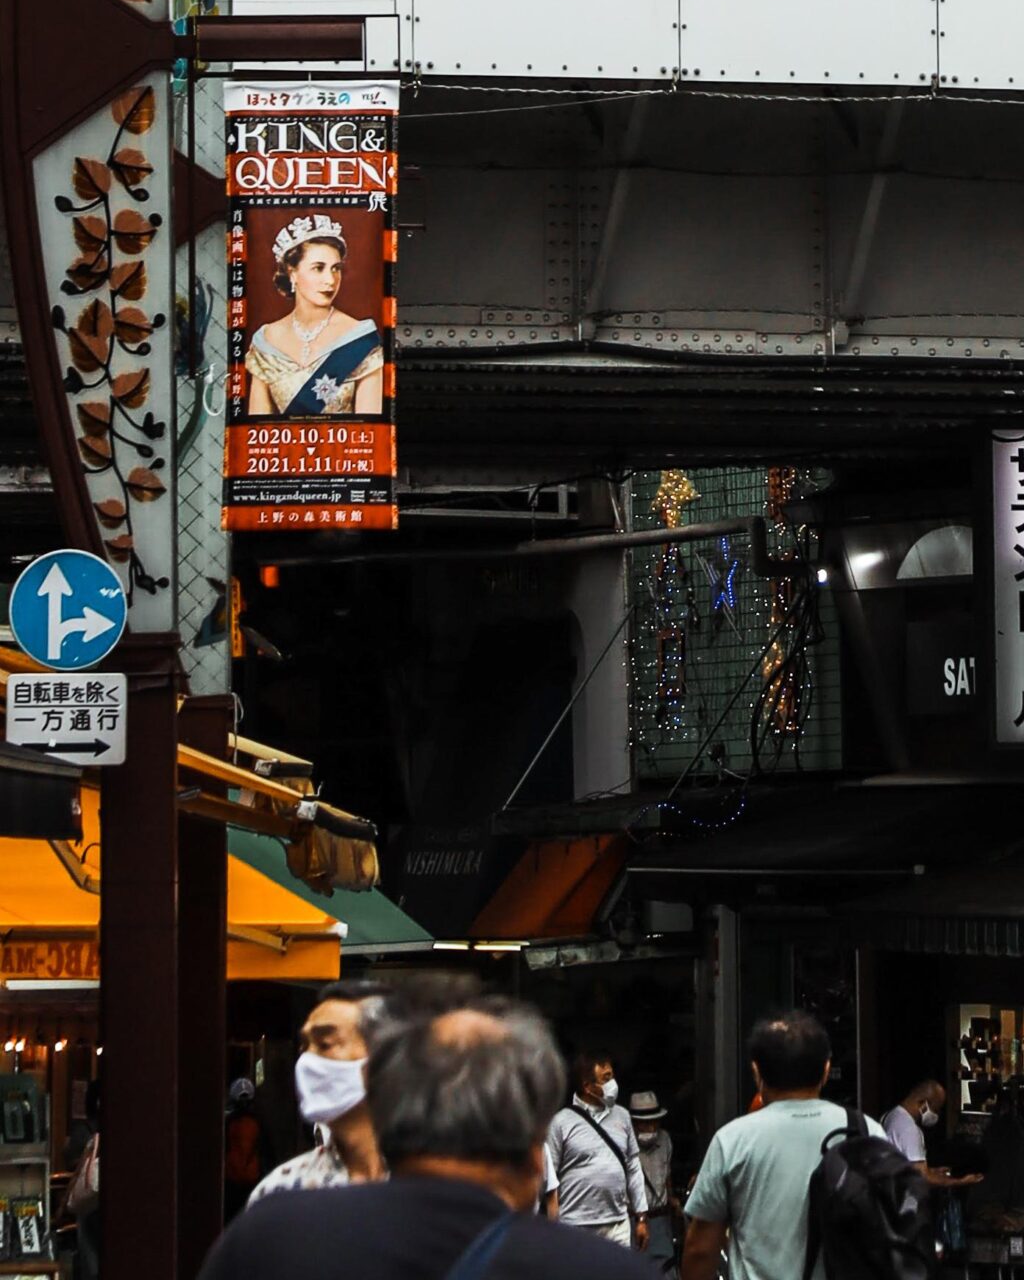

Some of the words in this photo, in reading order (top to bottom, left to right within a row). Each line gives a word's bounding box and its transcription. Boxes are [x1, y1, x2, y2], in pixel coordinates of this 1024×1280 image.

[236, 157, 388, 190] QUEEN
[247, 428, 347, 445] 2020.10.10
[247, 456, 331, 473] 2021.1.11
[257, 509, 364, 524] 上野の森美術館
[14, 682, 120, 704] 自転車を除く
[14, 709, 120, 732] 一方通行
[404, 849, 485, 876] NISHIMURA
